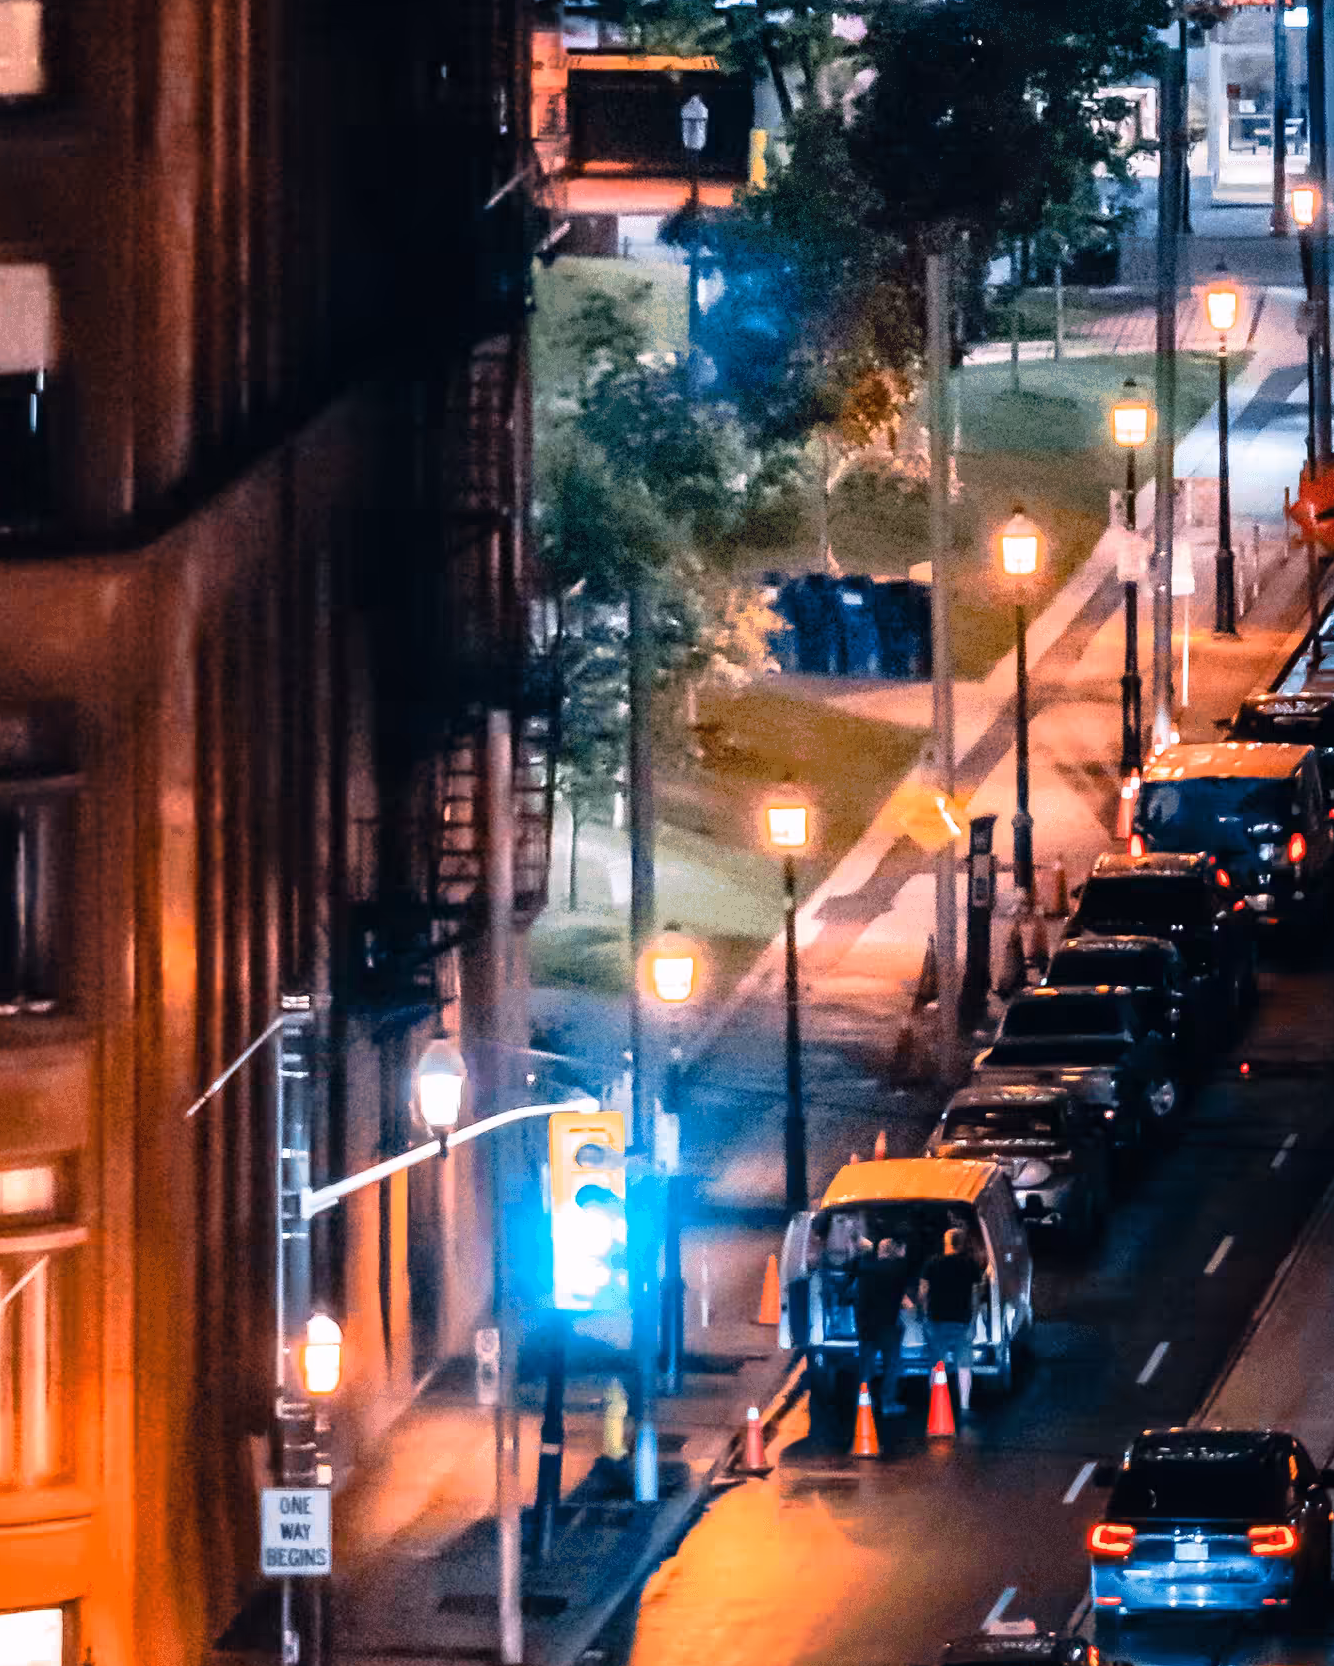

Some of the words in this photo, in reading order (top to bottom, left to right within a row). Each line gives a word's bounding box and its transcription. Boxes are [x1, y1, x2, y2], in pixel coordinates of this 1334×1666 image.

[280, 1496, 312, 1515] ONE
[280, 1523, 311, 1541] WAY
[267, 1547, 327, 1566] BEGINS
